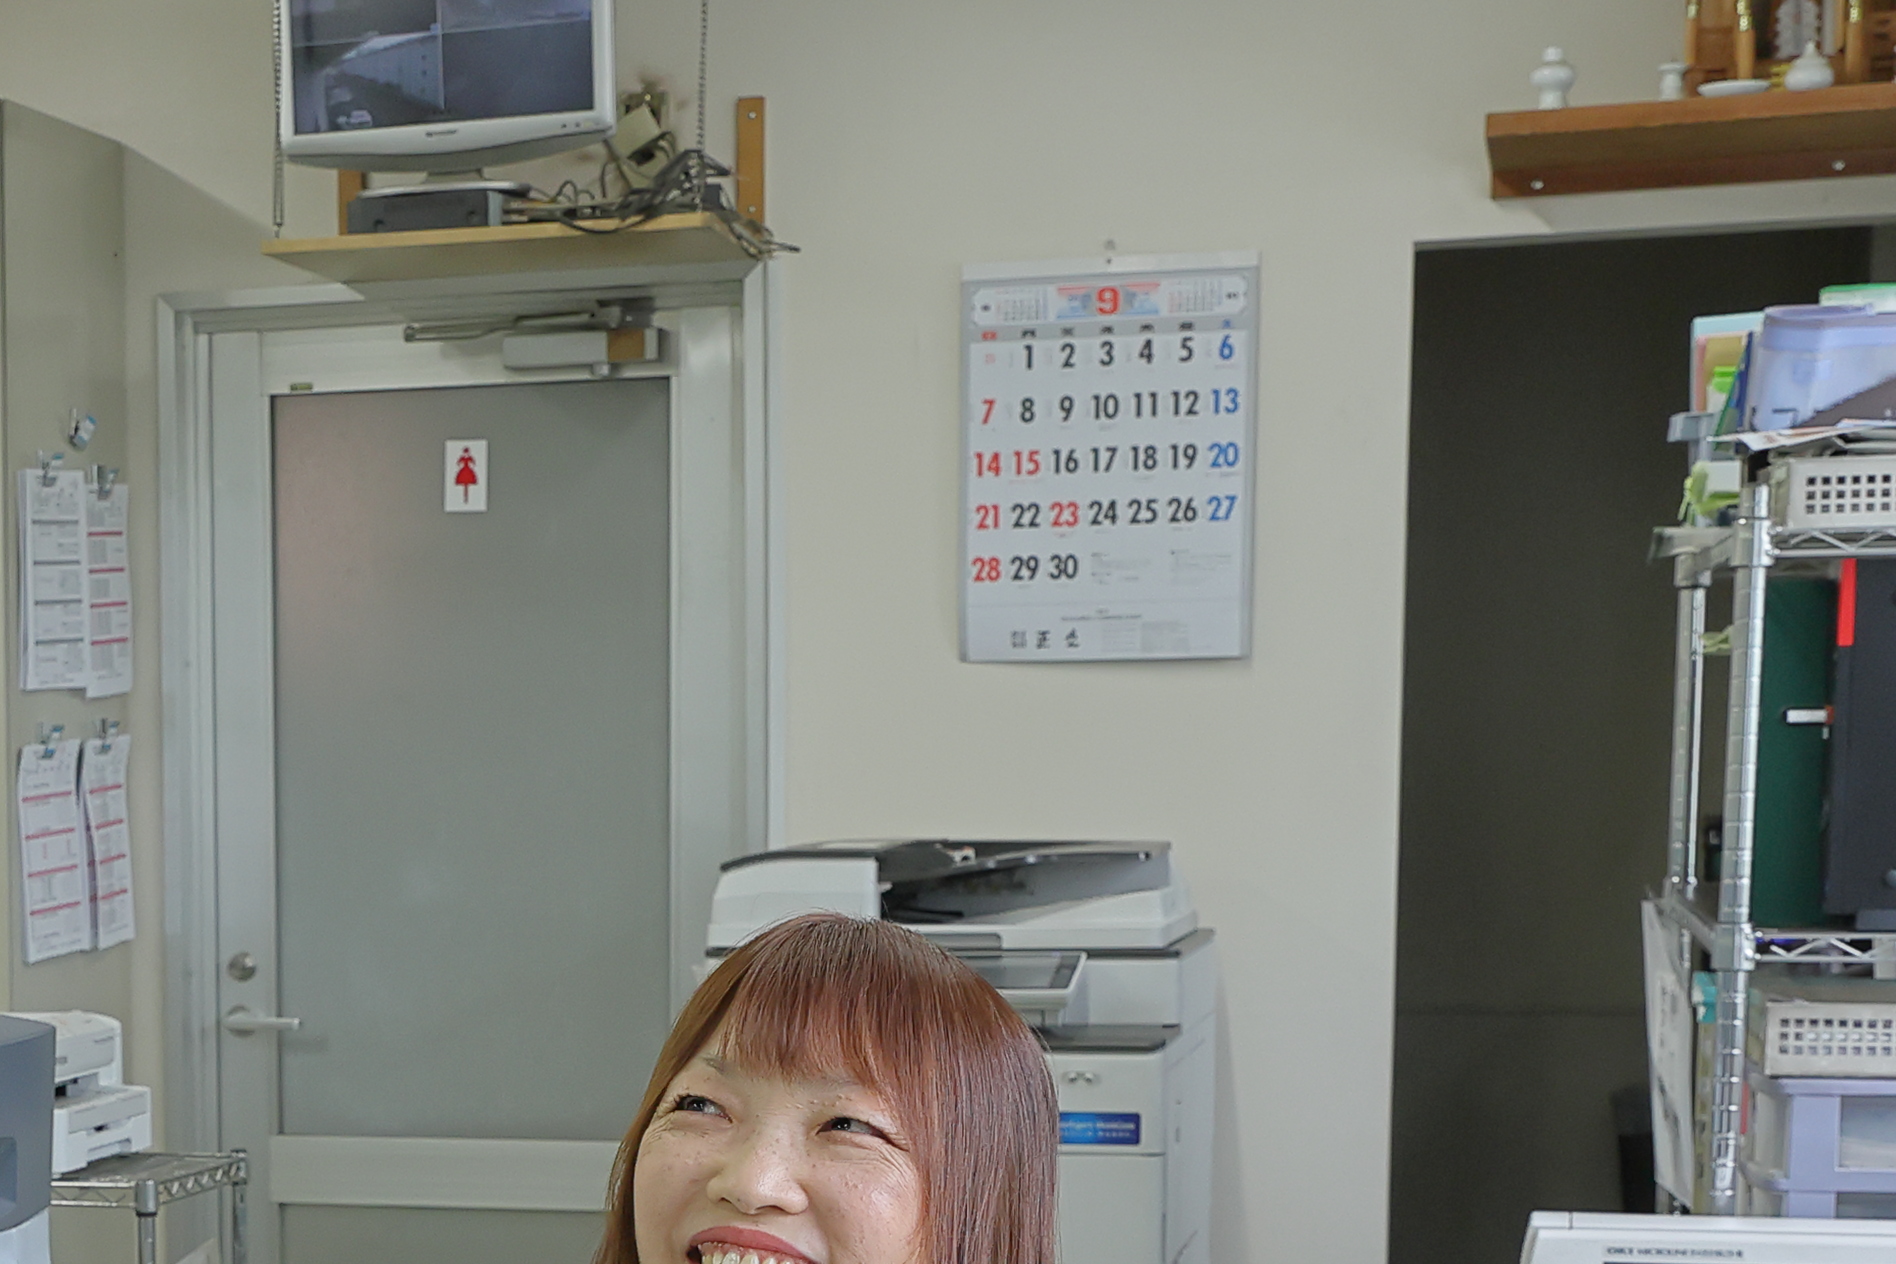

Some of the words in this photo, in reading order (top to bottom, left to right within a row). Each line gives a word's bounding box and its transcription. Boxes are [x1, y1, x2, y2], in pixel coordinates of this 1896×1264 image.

[1097, 287, 1119, 315] 9
[1023, 344, 1033, 371] 1
[1060, 342, 1076, 369] 2
[1099, 340, 1115, 367] 3
[1138, 338, 1154, 365] 4
[1178, 336, 1194, 363] 5
[1218, 334, 1235, 361] 6
[982, 399, 996, 425] 7
[1019, 397, 1036, 424] 8
[1059, 395, 1074, 422] 9
[1092, 393, 1120, 420] 10
[1133, 391, 1158, 418] 11
[1171, 389, 1200, 417] 12
[1212, 387, 1239, 415] 13
[975, 451, 1001, 477] 14
[1013, 450, 1040, 476] 15
[1052, 448, 1079, 475] 16
[1090, 446, 1119, 473] 17
[1130, 444, 1158, 472] 18
[1170, 443, 1198, 470] 19
[1207, 441, 1240, 469] 20
[975, 504, 1000, 530] 21
[1011, 502, 1041, 529] 22
[1049, 501, 1080, 527] 23
[1087, 499, 1118, 526] 24
[1127, 498, 1158, 525] 25
[1167, 496, 1198, 523] 26
[1206, 494, 1238, 522] 27
[971, 556, 1001, 582] 28
[1010, 555, 1040, 581] 29
[1049, 553, 1079, 580] 30
